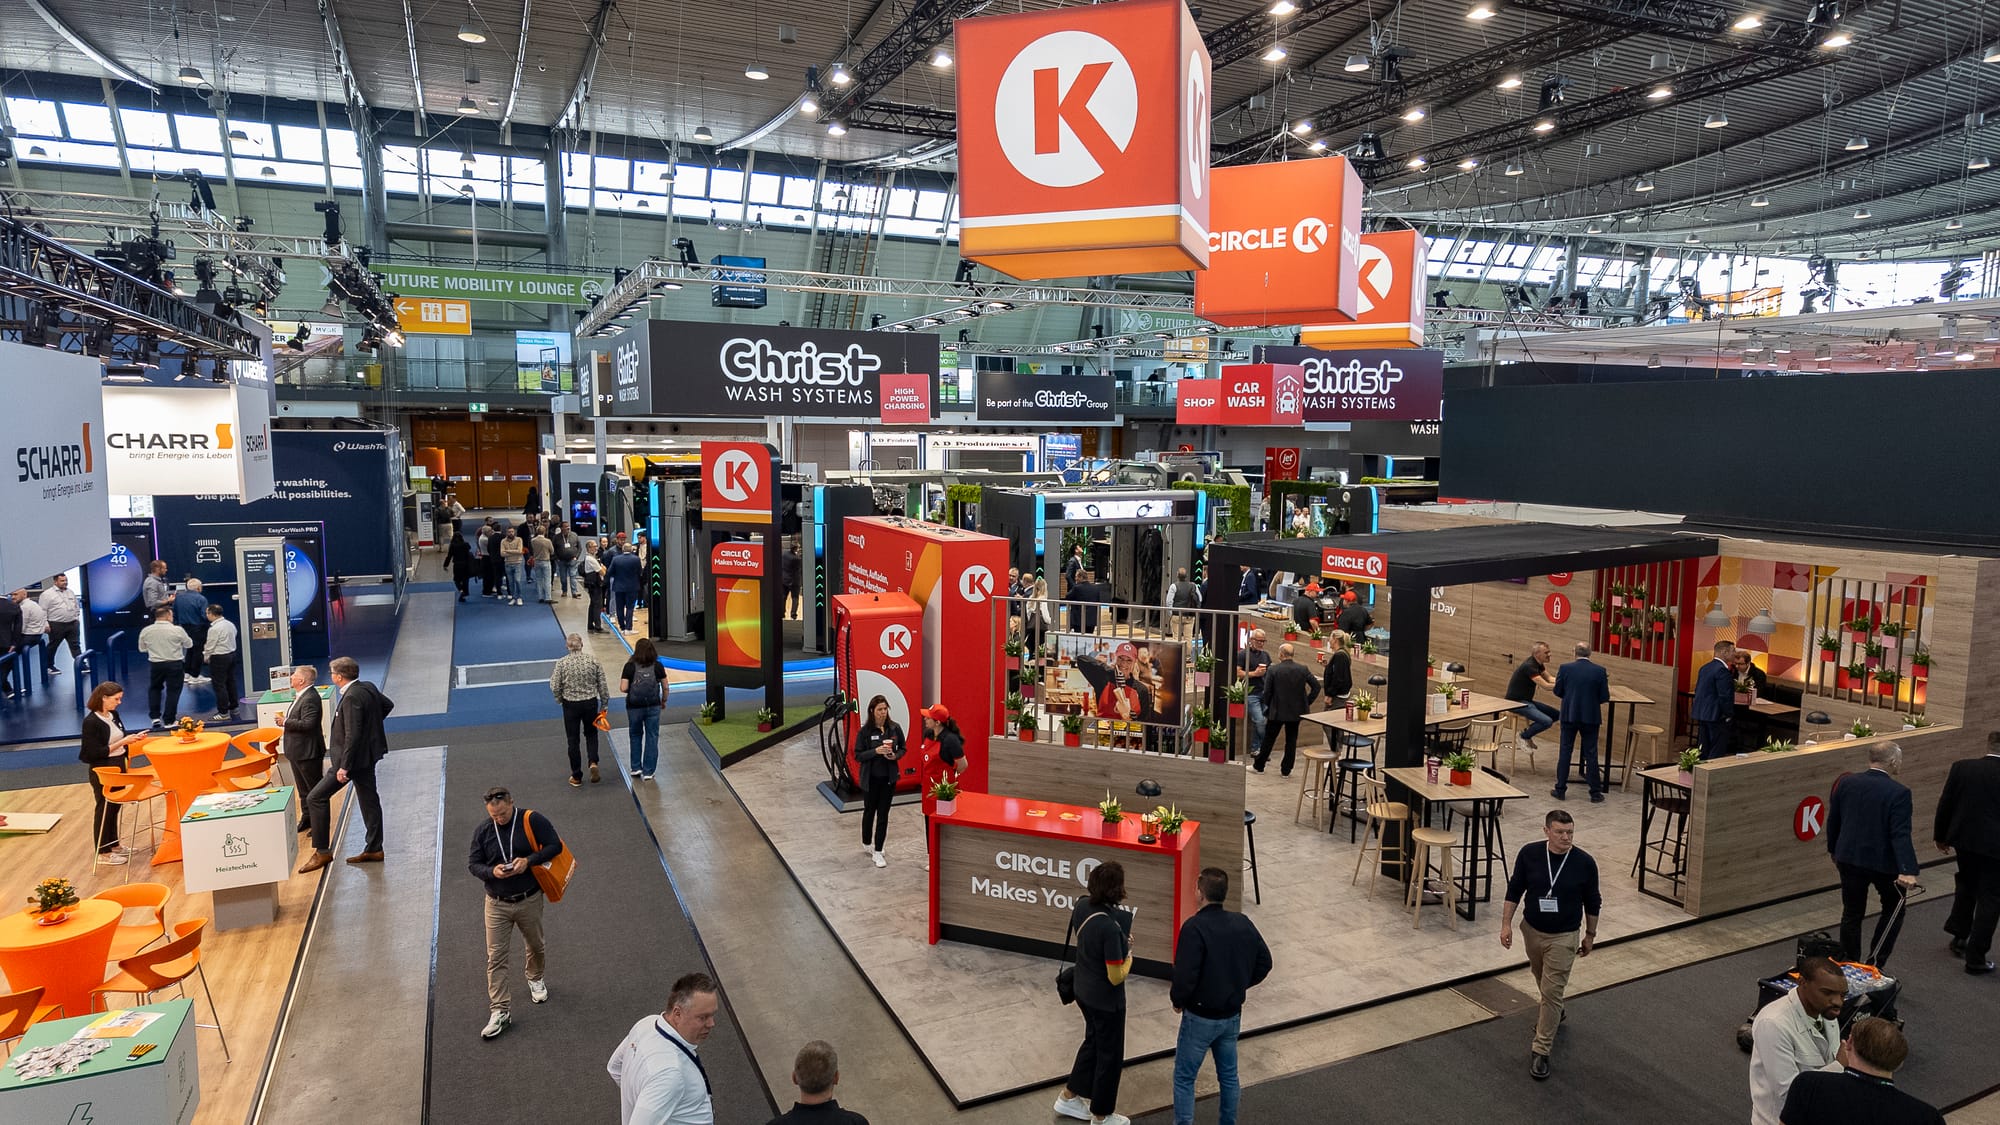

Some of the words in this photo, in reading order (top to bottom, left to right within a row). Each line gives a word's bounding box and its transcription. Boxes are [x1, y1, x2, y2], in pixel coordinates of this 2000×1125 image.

[1029, 57, 1128, 176] K
[1209, 227, 1287, 253] CIRCLE
[380, 272, 439, 289] FUTURE
[445, 276, 514, 293] MOBILITY
[519, 280, 576, 297] LOUNGE
[720, 338, 882, 386] Christ
[1300, 358, 1403, 395] Christ
[1233, 382, 1260, 395] CAR
[725, 387, 783, 402] WASH
[792, 388, 873, 405] SYSTEMS
[890, 395, 920, 403] POWER
[986, 398, 996, 407] Be
[997, 399, 1012, 409] part
[1013, 398, 1021, 407] of
[1022, 399, 1034, 408] the
[1035, 390, 1088, 408] Christ
[1086, 400, 1109, 410] Group
[1183, 397, 1216, 408] SHOP
[1227, 396, 1266, 408] WASH
[884, 402, 926, 411] CHARGING
[1341, 397, 1396, 410] SYSTEMS
[1410, 424, 1439, 434] WASH
[129, 451, 155, 460] bringt
[157, 451, 190, 460] Energie
[192, 451, 205, 459] ins
[206, 451, 233, 460] Leben
[17, 445, 82, 483] SCHARR
[283, 478, 329, 489] washing.
[722, 458, 757, 501] K
[272, 490, 286, 499] All
[288, 489, 352, 501] possibilities.
[110, 555, 128, 564] 40
[720, 550, 742, 558] CIRCLE
[714, 559, 733, 567] Makes
[733, 559, 747, 567] Your
[747, 560, 760, 569] Day
[1326, 554, 1364, 570] CIRCLE
[1438, 602, 1457, 617] Day
[1801, 803, 1822, 836] K
[215, 861, 258, 873] Heiztechnik
[995, 851, 1071, 879] CIRCLE
[971, 876, 1038, 905] Makes
